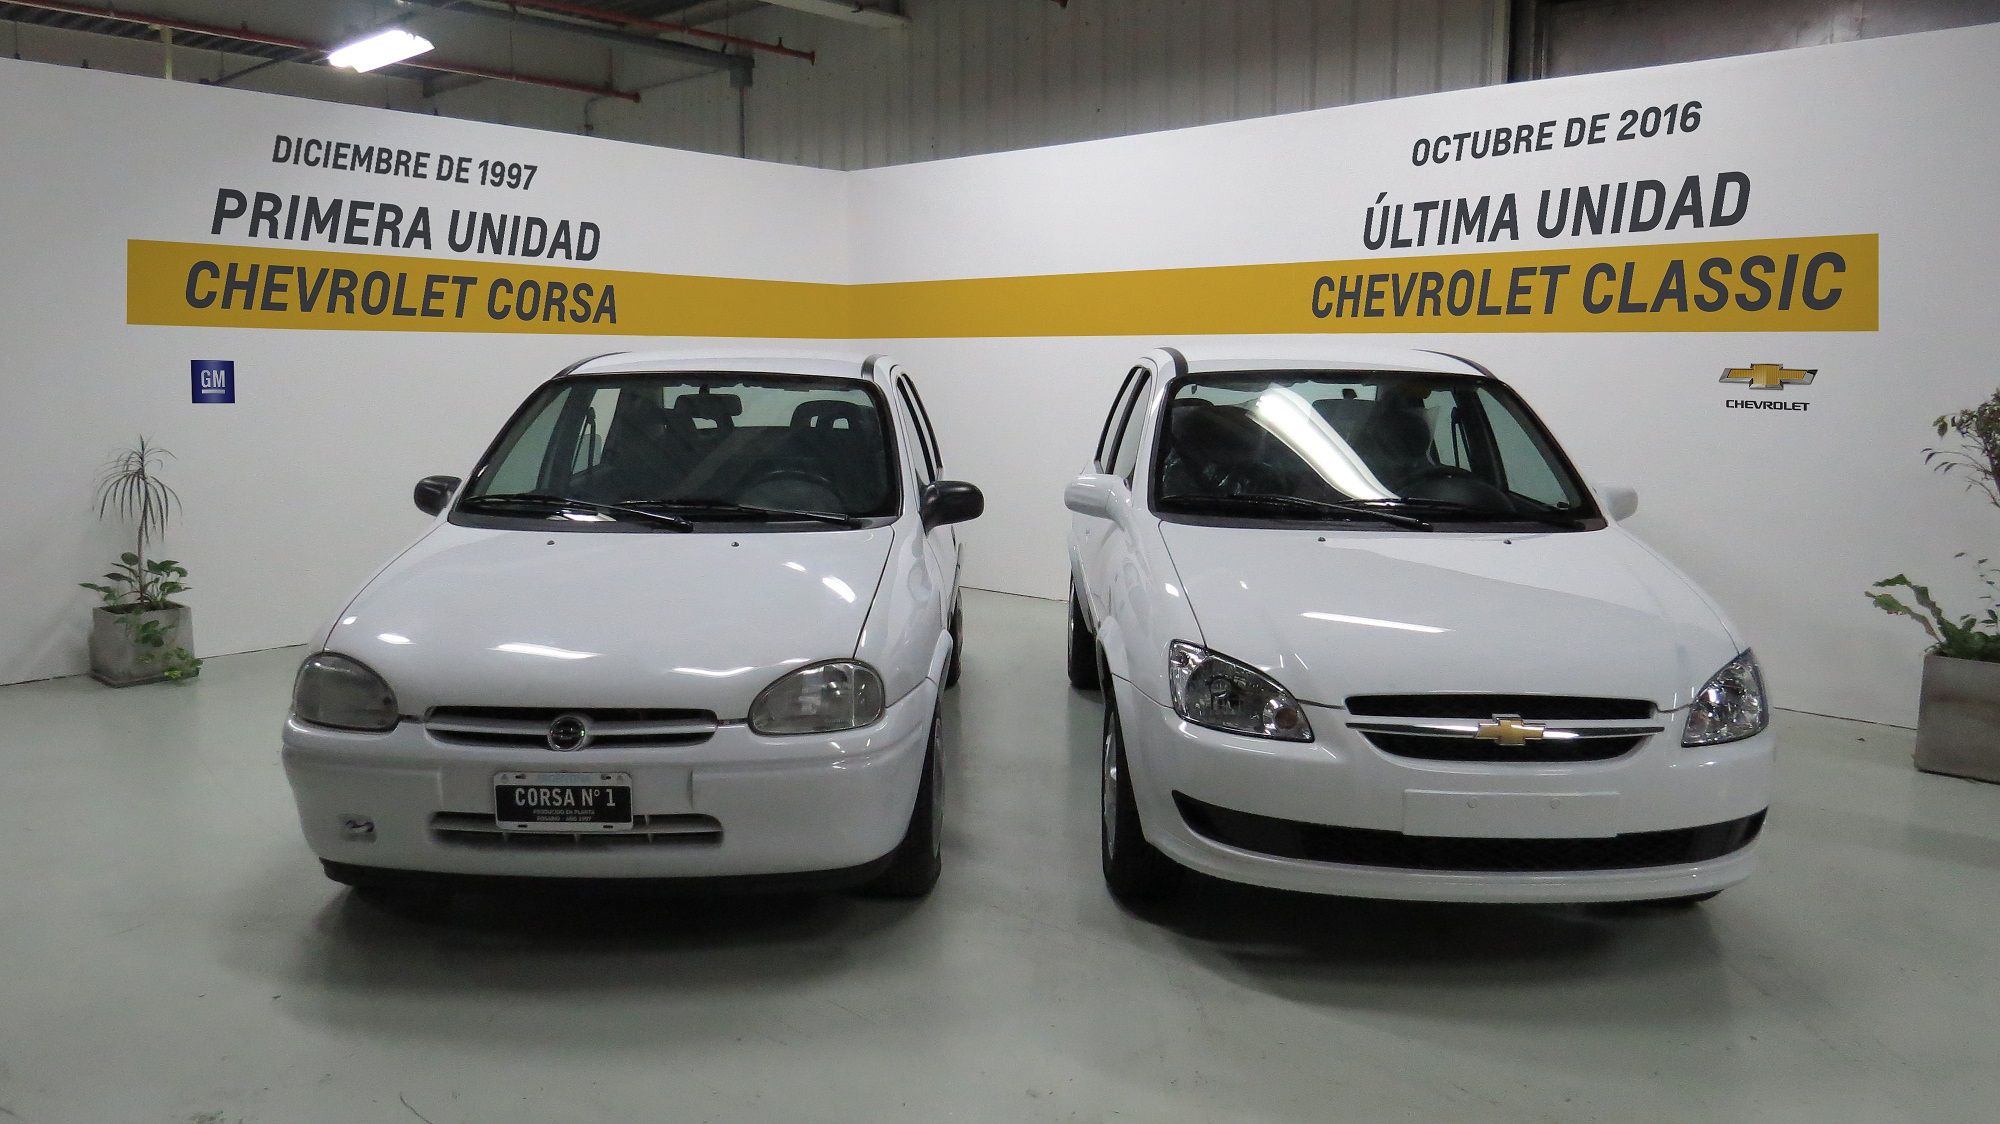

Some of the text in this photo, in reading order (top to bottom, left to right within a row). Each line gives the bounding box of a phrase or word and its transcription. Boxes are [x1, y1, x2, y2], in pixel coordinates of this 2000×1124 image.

[272, 135, 538, 191] DICIEMBRE DE 1997
[1412, 101, 1703, 167] OCTUBRE DE 2016
[210, 188, 602, 262] PRIMERA UNIDAD
[1363, 171, 1752, 251] ÚLTIMA UNIDAD
[185, 260, 618, 325] CHEVROLET CORSA
[1311, 252, 1848, 319] CHEVROLET CLASSIC
[201, 369, 226, 388] GM
[1725, 399, 1811, 412] CHEVROLET
[515, 788, 576, 807] CORSA
[605, 788, 616, 807] 1
